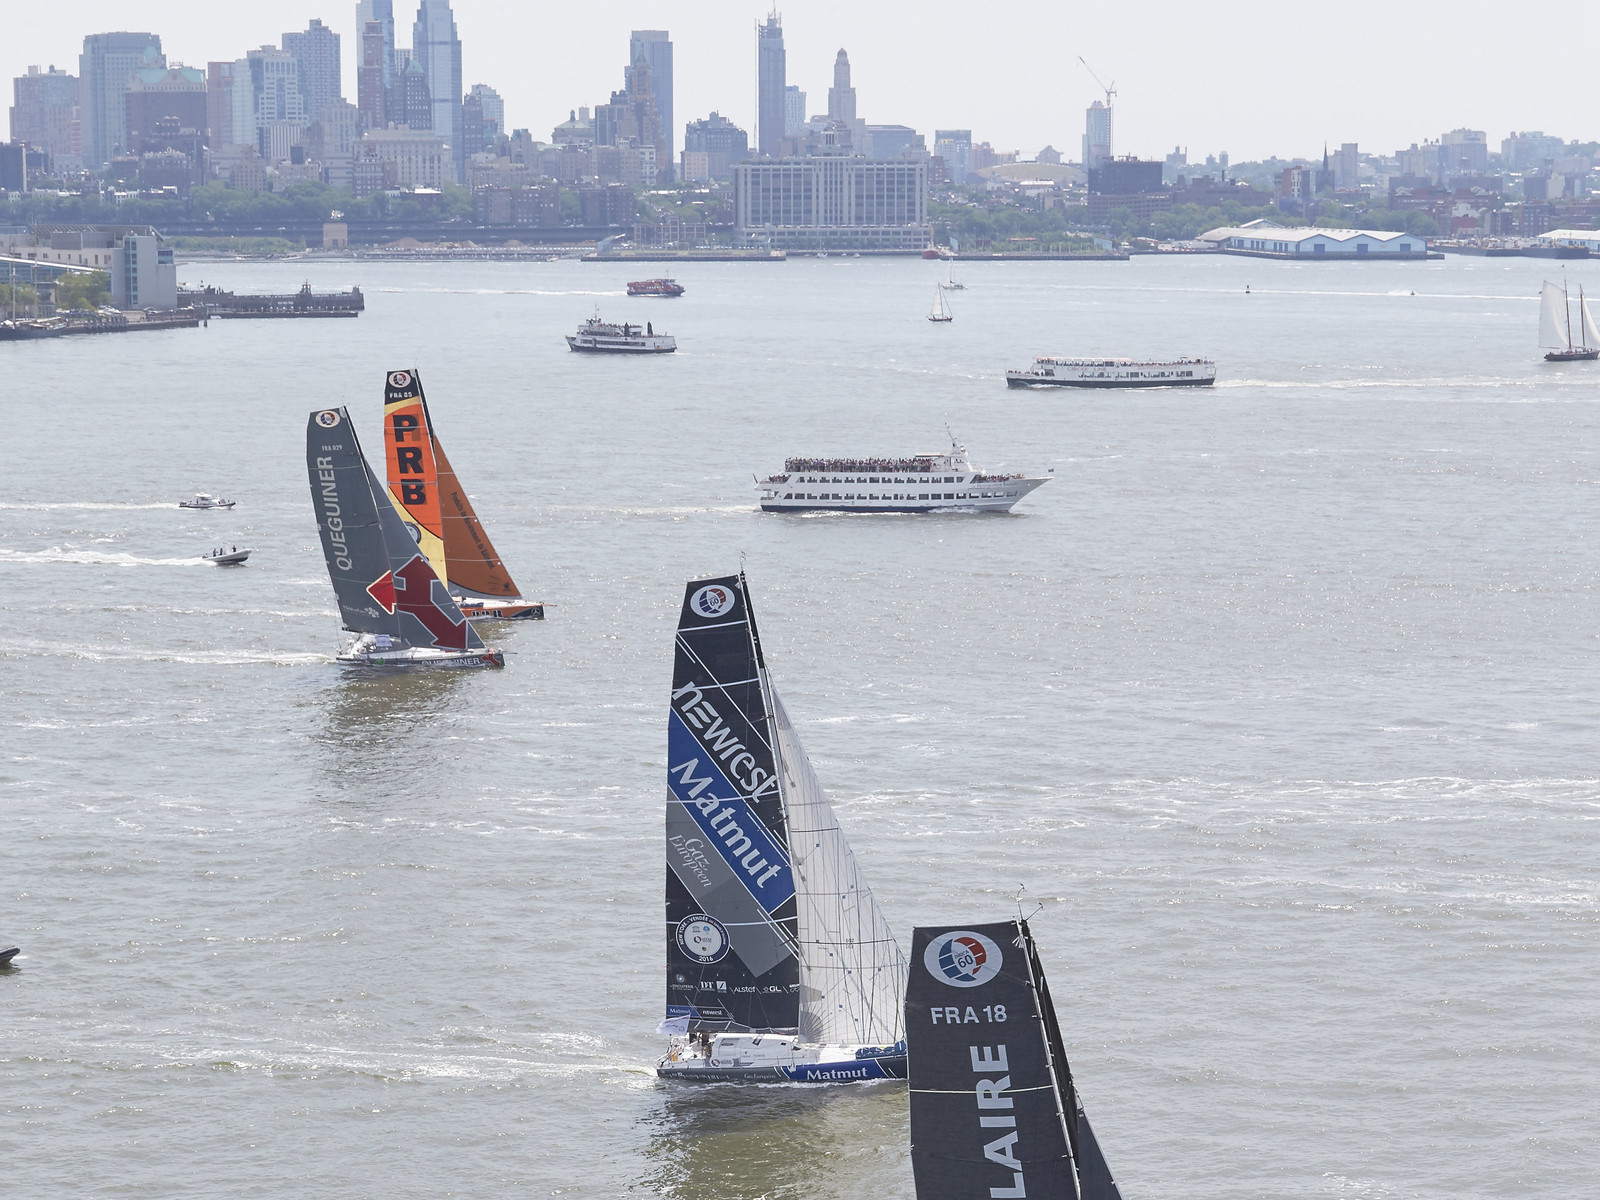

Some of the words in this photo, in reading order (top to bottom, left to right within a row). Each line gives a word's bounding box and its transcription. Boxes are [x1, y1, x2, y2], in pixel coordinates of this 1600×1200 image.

[393, 414, 424, 505] PRB
[317, 456, 353, 571] QUEGUINER
[670, 757, 781, 889] Matmut
[669, 834, 712, 887] Européen
[958, 954, 974, 968] 60
[930, 1006, 980, 1025] FRA
[982, 1004, 1008, 1023] 18
[806, 1067, 868, 1080] Matmut
